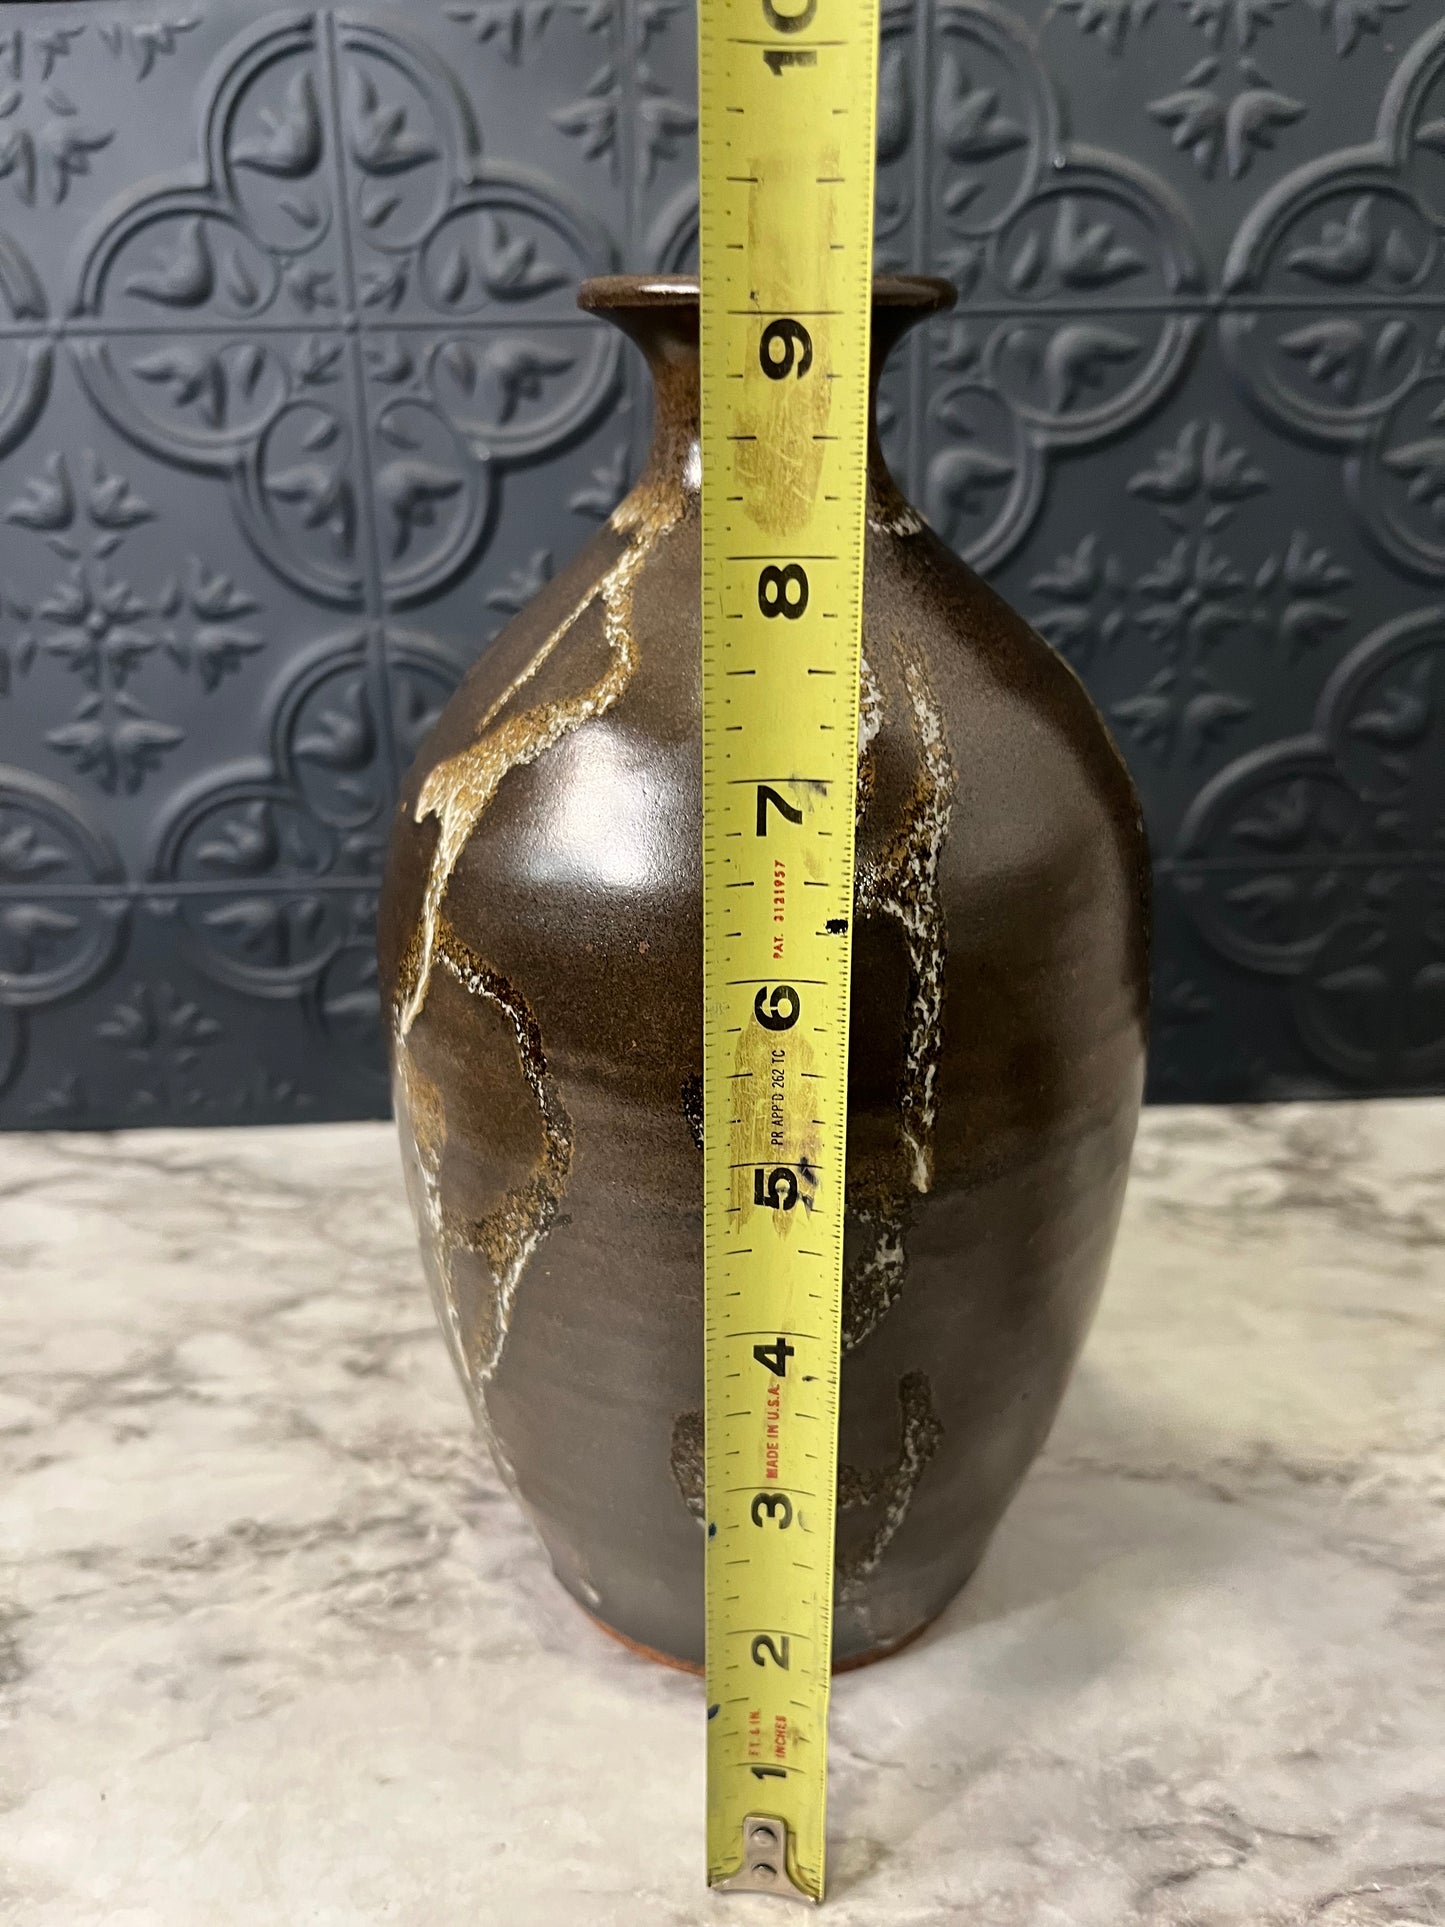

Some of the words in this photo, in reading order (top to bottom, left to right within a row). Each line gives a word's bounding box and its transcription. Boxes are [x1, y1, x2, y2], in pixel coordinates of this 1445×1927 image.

[759, 318, 813, 380] 9
[758, 564, 809, 620] 8
[756, 785, 803, 836] 7
[773, 860, 785, 922] 3121957
[772, 933, 784, 960] PAT.
[754, 985, 800, 1031] 6
[772, 1050, 785, 1064] TC
[772, 1069, 785, 1089] 262
[772, 1093, 785, 1127] APP'D
[771, 1131, 784, 1146] PR
[754, 1167, 798, 1211] 5
[753, 1337, 795, 1377] 4
[767, 1384, 780, 1420] U.S.A.
[767, 1425, 779, 1438] IN
[766, 1442, 779, 1479] MADE
[751, 1492, 793, 1530] 3
[751, 1634, 790, 1671] 2
[775, 1715, 787, 1758] INCHES
[751, 1767, 787, 1779] 1
